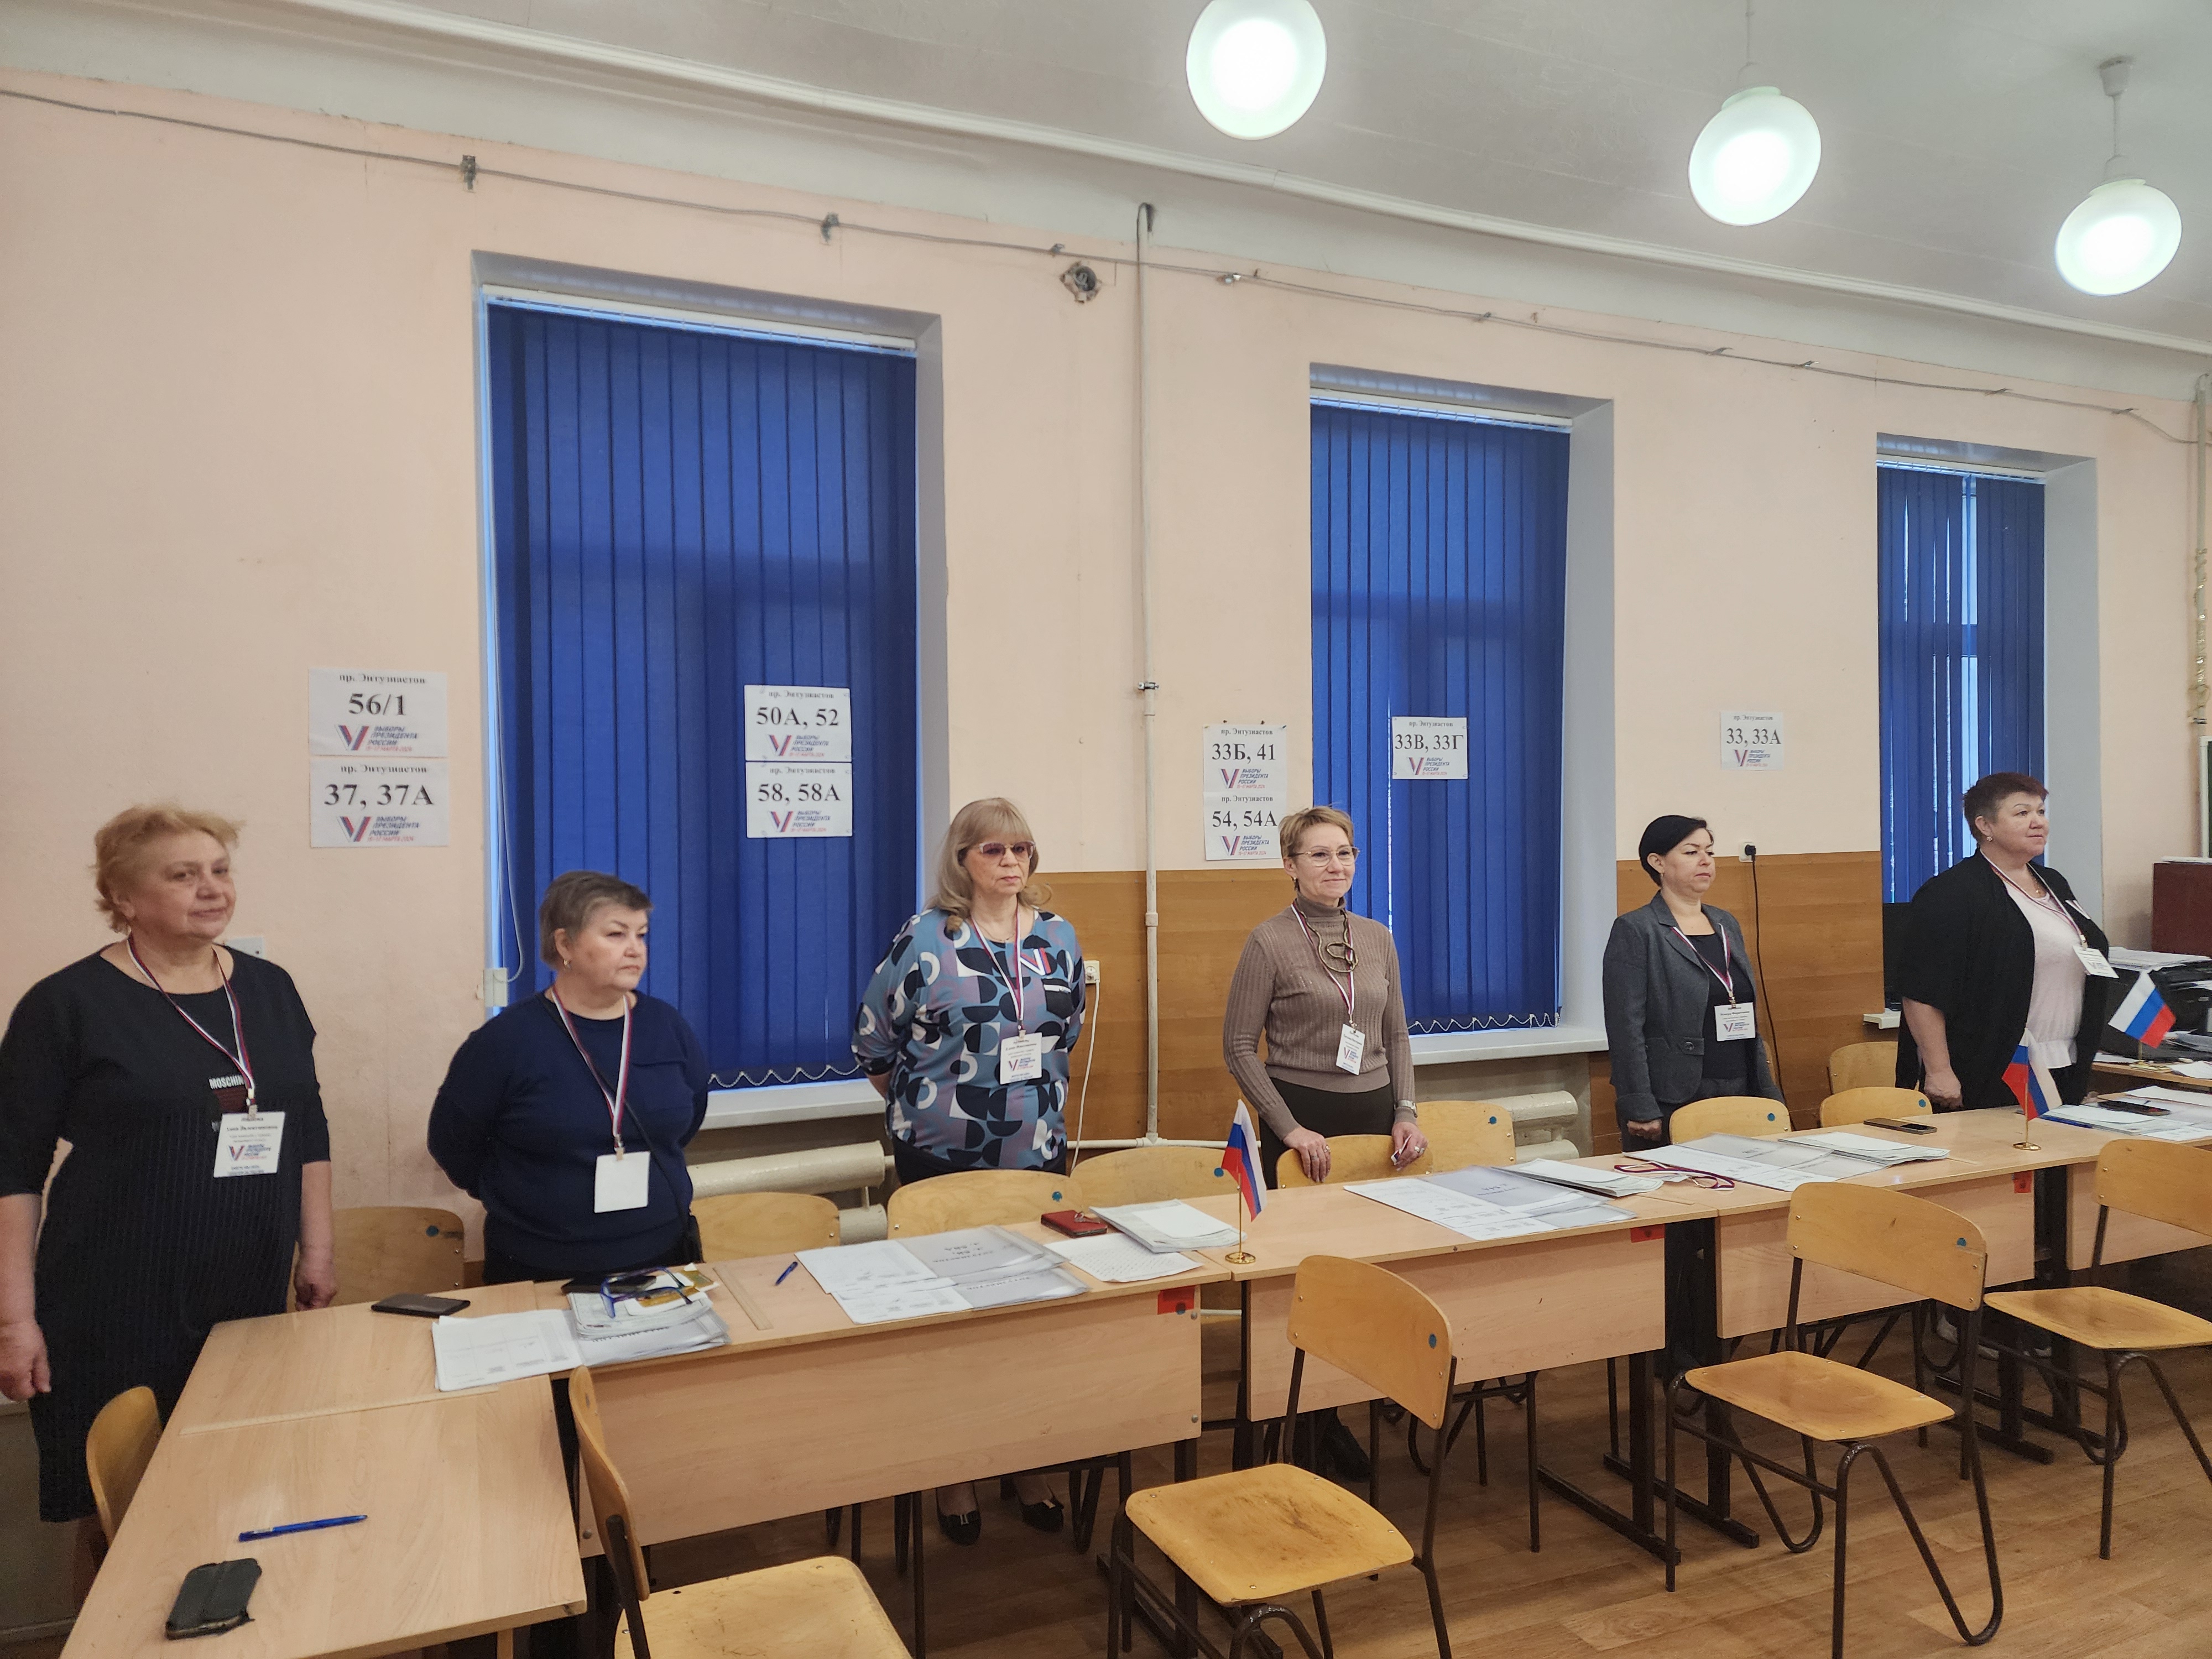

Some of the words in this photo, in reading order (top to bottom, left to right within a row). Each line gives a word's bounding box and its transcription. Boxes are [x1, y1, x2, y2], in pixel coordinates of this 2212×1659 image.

[348, 693, 406, 716] 56/1
[756, 706, 809, 729] 50А,
[815, 708, 839, 726] 52
[1395, 734, 1429, 753] 33В,
[1433, 734, 1464, 750] 33Г
[1726, 728, 1748, 748] 33,
[1752, 728, 1782, 744] 33А
[1212, 743, 1251, 764] 33Б,
[1257, 743, 1276, 760] 41
[324, 784, 367, 810] 37,
[377, 784, 435, 806] 37А
[758, 782, 791, 805] 58,
[798, 782, 841, 802] 58А
[1212, 810, 1238, 831] 54,
[1243, 810, 1277, 827] 54А
